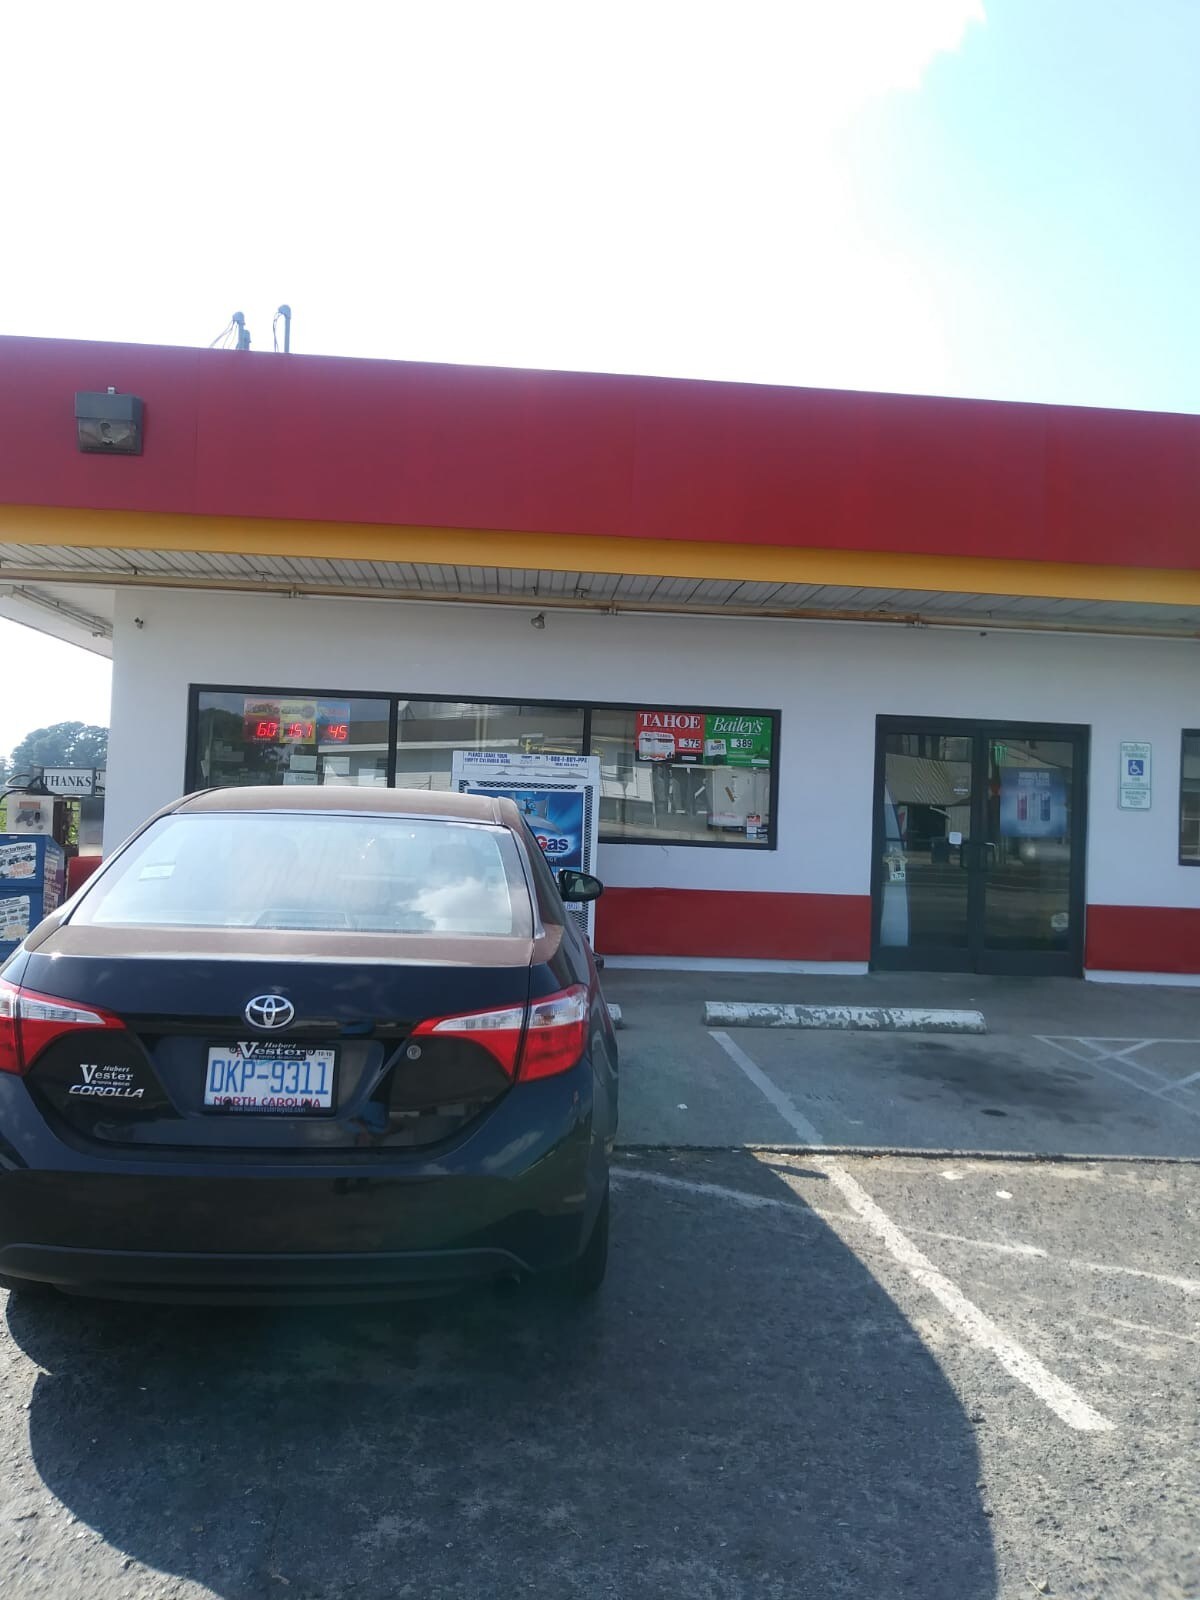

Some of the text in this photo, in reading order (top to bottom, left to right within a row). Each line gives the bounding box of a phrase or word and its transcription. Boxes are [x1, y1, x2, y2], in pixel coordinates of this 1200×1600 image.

[640, 713, 700, 729] TAHOE
[257, 722, 277, 738] 60
[329, 725, 349, 740] 45
[684, 739, 701, 748] 375
[735, 739, 752, 748] 389
[44, 775, 92, 787] THANKS
[237, 1041, 306, 1059] Vester
[80, 1064, 134, 1084] Vester
[209, 1059, 329, 1095] DKP-9311
[69, 1085, 145, 1098] COROLLA
[213, 1096, 321, 1108] NORTH CAROLINA
